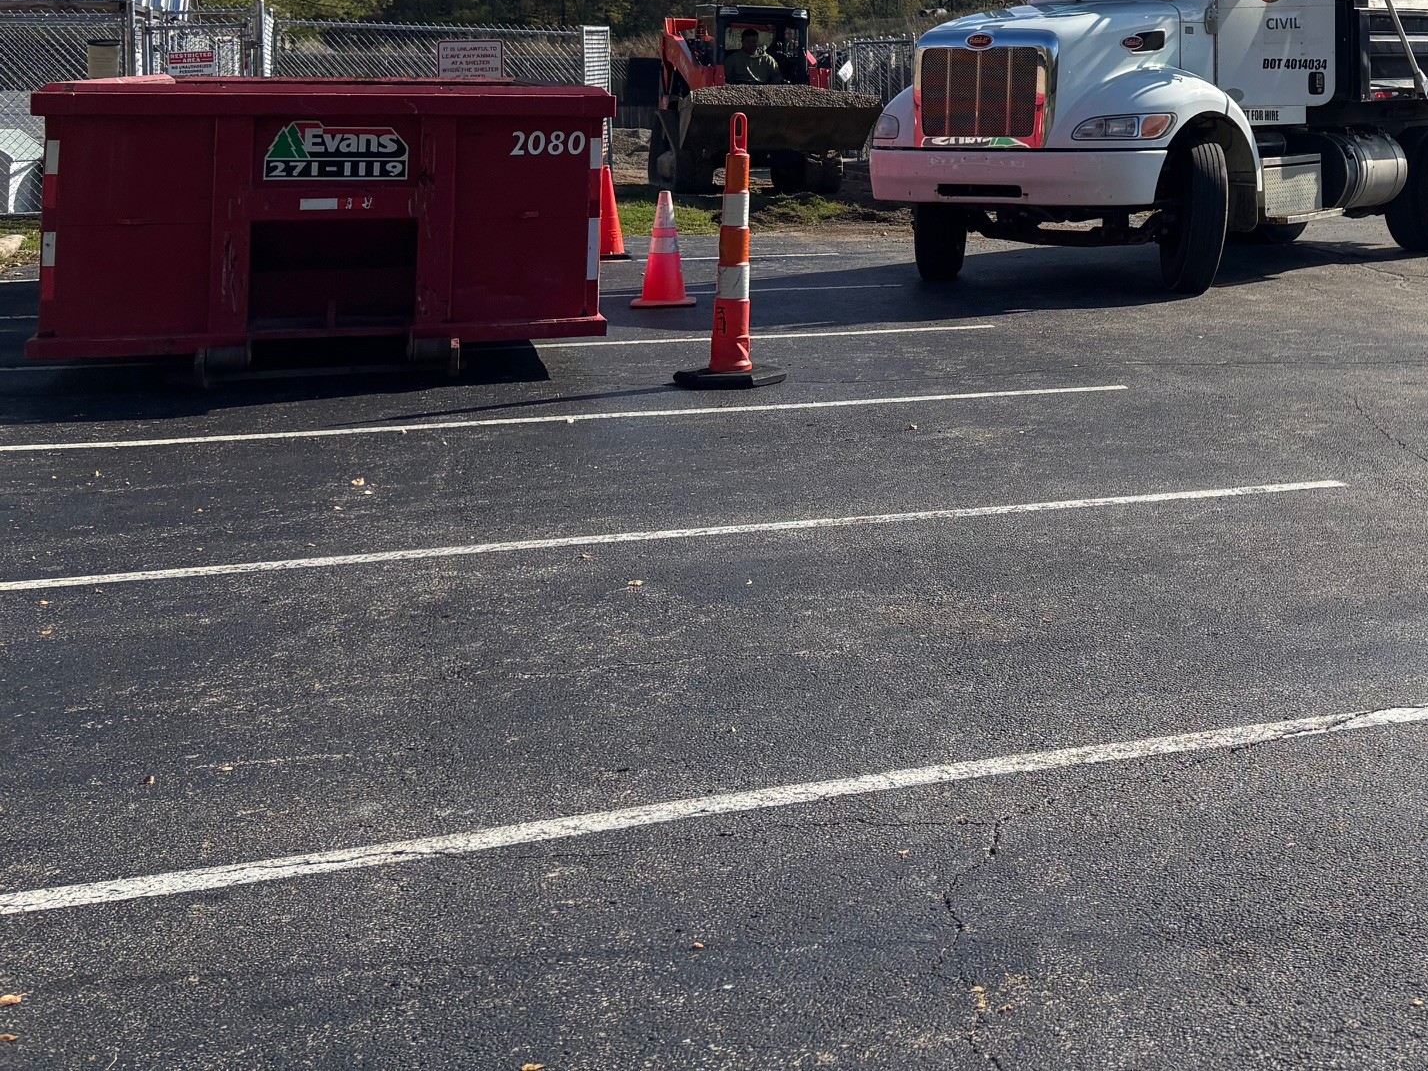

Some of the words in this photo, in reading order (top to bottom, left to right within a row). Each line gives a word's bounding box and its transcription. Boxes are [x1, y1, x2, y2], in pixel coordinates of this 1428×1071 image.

[1265, 17, 1301, 30] CIVIL
[1262, 58, 1283, 69] DOT
[1284, 58, 1327, 70] 4014034
[1251, 110, 1263, 121] FOR
[1264, 110, 1279, 121] HIRE
[304, 128, 398, 153] Evans
[509, 131, 586, 155] 2080
[268, 161, 403, 176] 271-1119
